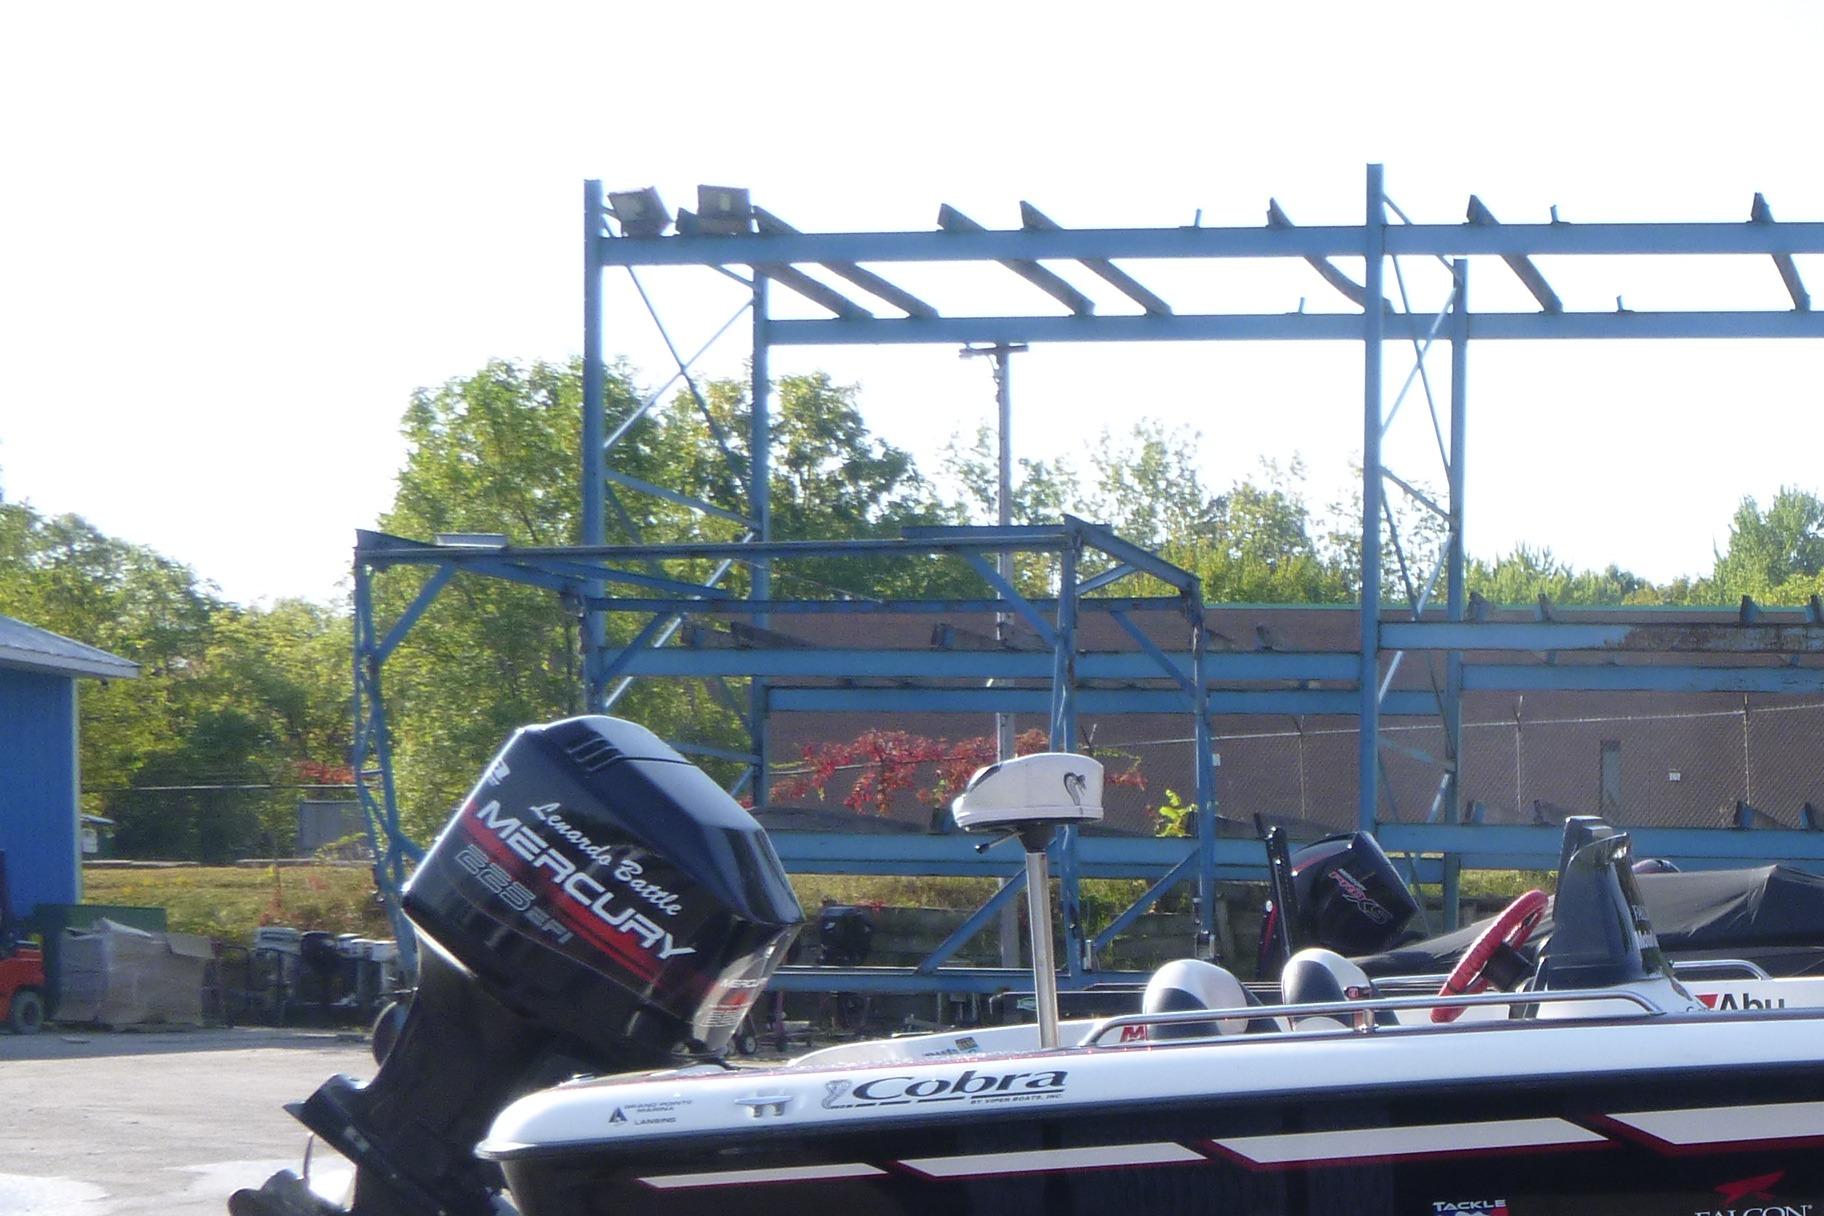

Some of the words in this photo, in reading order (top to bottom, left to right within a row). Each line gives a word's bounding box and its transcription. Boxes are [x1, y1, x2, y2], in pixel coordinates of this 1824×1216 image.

[455, 844, 537, 912] 225
[476, 800, 697, 960] MERCURY
[613, 859, 683, 916] Battle
[852, 1070, 1068, 1101] Cobra
[1432, 1200, 1506, 1212] TACKLE
